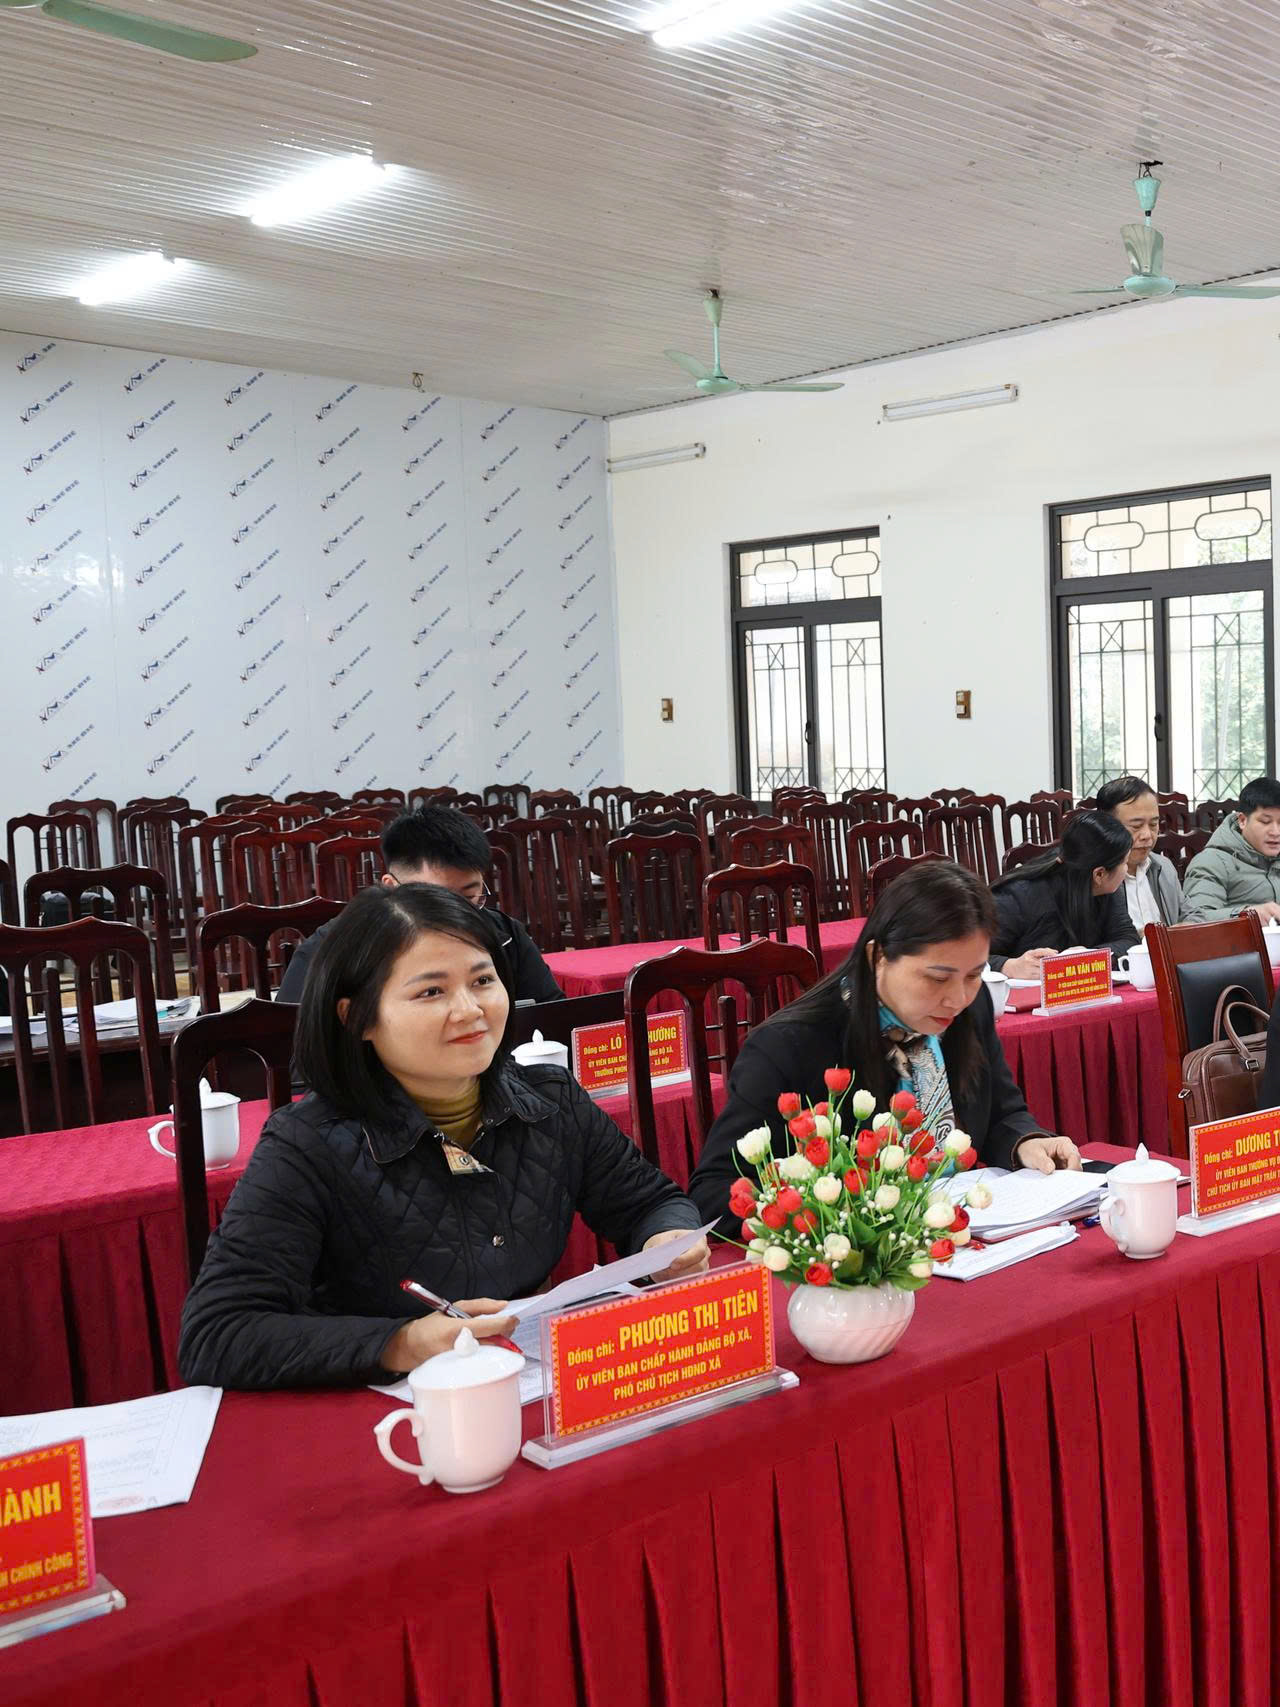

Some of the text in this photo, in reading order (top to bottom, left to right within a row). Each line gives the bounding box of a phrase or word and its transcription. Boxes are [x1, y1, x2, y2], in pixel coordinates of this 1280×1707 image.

[1066, 965, 1076, 977] MA
[1077, 962, 1090, 975] VĂN
[1204, 1153, 1220, 1165] Đồng
[1235, 1132, 1271, 1156] DƯƠNG
[1237, 1164, 1248, 1175] BAN
[568, 1288, 759, 1367] Đồng chí: PHƯỢNG THỊ TIÊN
[576, 1374, 589, 1391] ỦY
[592, 1366, 615, 1387] VIÊN
[617, 1363, 638, 1380] BAN
[640, 1353, 666, 1376] CHẤP
[668, 1346, 694, 1364] HÀNH
[696, 1335, 721, 1357] ĐẢNG
[723, 1331, 736, 1349] BỘ
[614, 1357, 721, 1401] PHÓ CHỦ TỊCH HĐND XÃ
[0, 1481, 62, 1527] ÀNH
